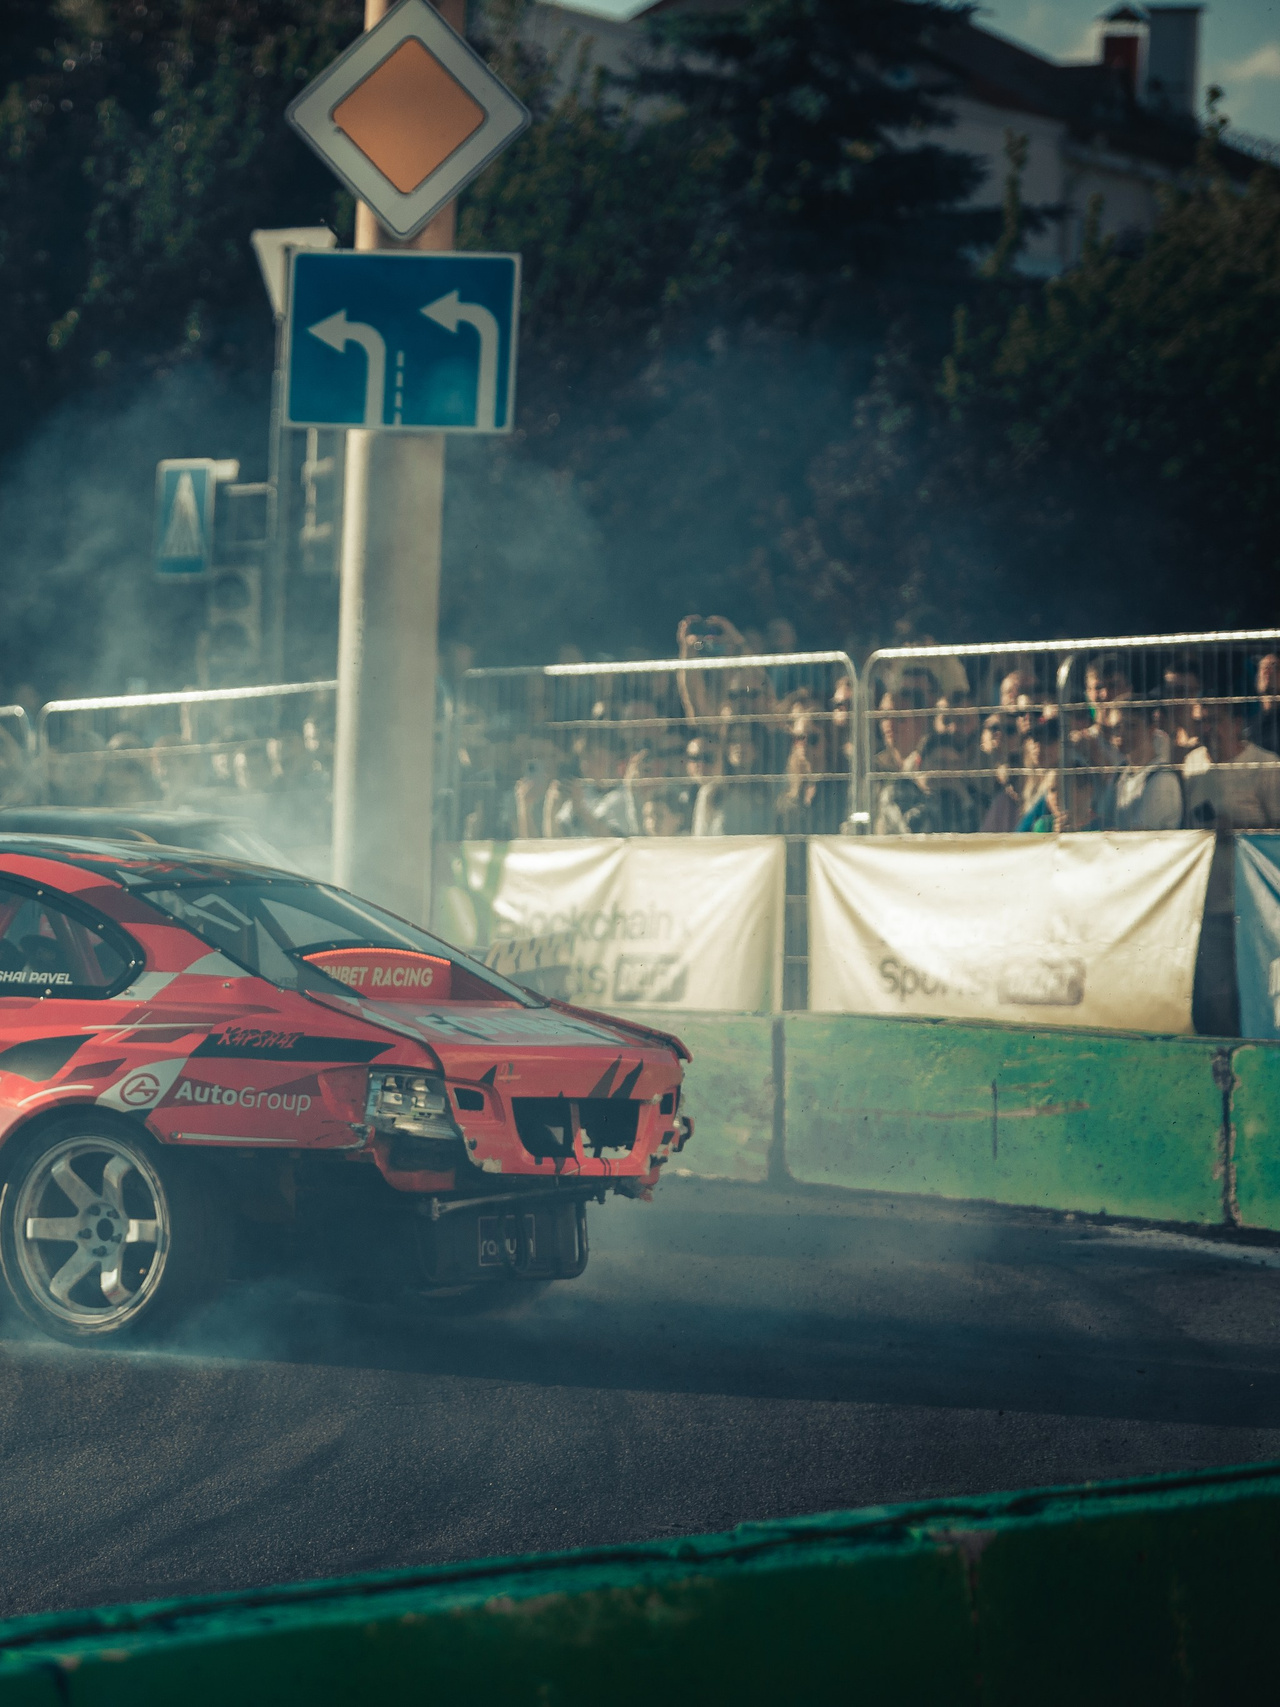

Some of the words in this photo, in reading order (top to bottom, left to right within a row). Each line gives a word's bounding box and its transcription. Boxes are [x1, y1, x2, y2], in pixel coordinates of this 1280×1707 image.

[29, 972, 73, 985] PAVEL
[372, 966, 433, 987] RACING
[174, 1080, 312, 1116] AutoGroup
